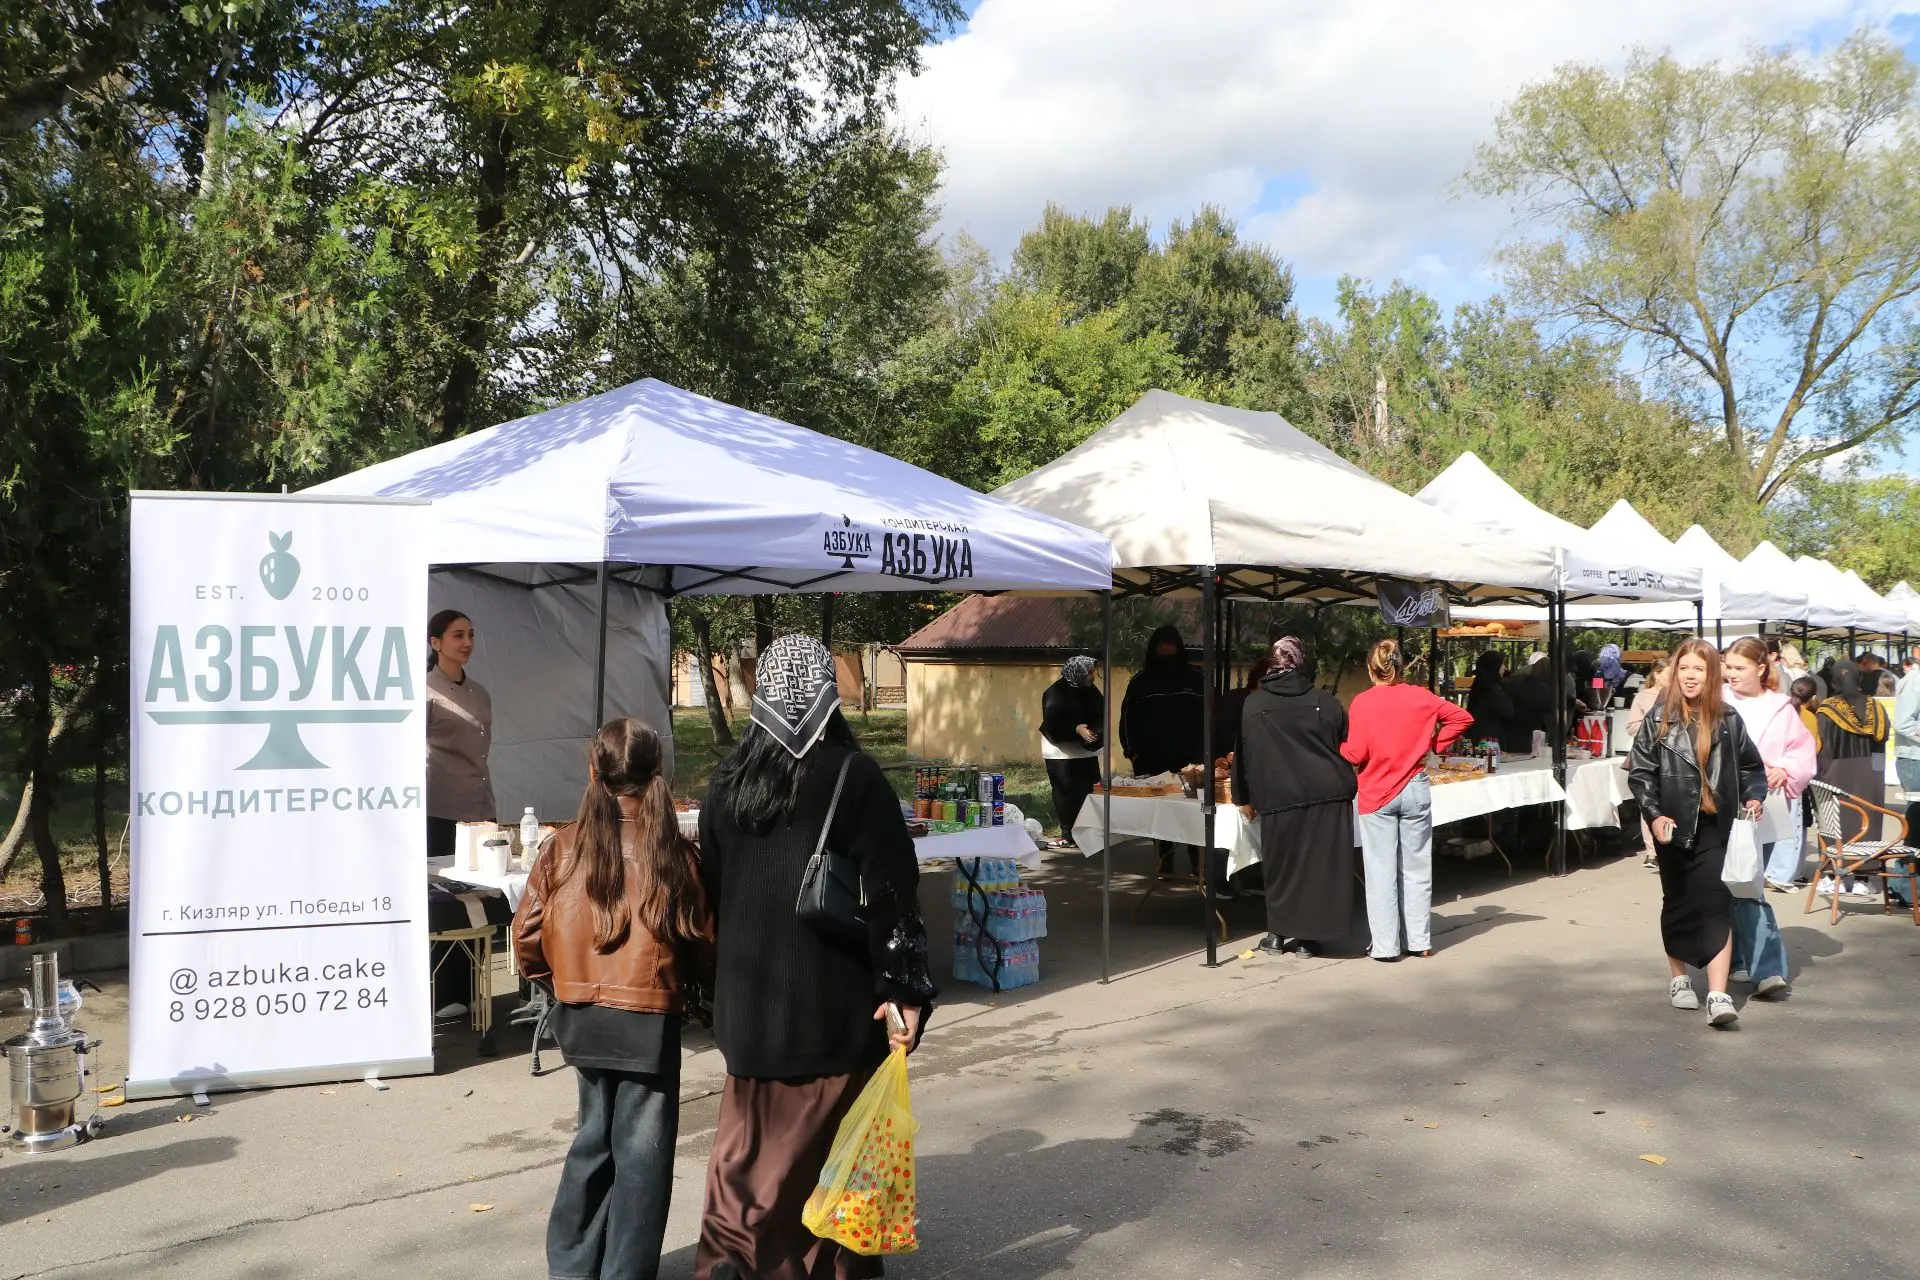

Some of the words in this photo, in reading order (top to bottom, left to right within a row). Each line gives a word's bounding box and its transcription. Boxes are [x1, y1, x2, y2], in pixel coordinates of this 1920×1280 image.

[880, 518, 969, 533] КОНДИТЕРСКАЯ
[823, 531, 873, 552] АЗБУКА
[880, 532, 973, 578] АЗБУКА
[1583, 569, 1603, 579] COFFEE
[195, 585, 244, 600] EST.
[311, 586, 369, 601] 2000
[144, 624, 415, 703] АЗБУКА
[137, 786, 421, 819] КОНДИТЕРСКАЯ
[162, 909, 173, 921] г.
[179, 905, 250, 920] Кизляр
[256, 904, 283, 920] ул.
[290, 898, 364, 915] Победы
[372, 896, 392, 911] 18
[169, 967, 198, 995] @
[208, 957, 386, 988] azbuka.cake
[169, 1001, 185, 1022] 8
[194, 997, 247, 1020] 928
[256, 992, 307, 1016] 050
[316, 989, 348, 1012] 72
[357, 986, 389, 1009] 84
